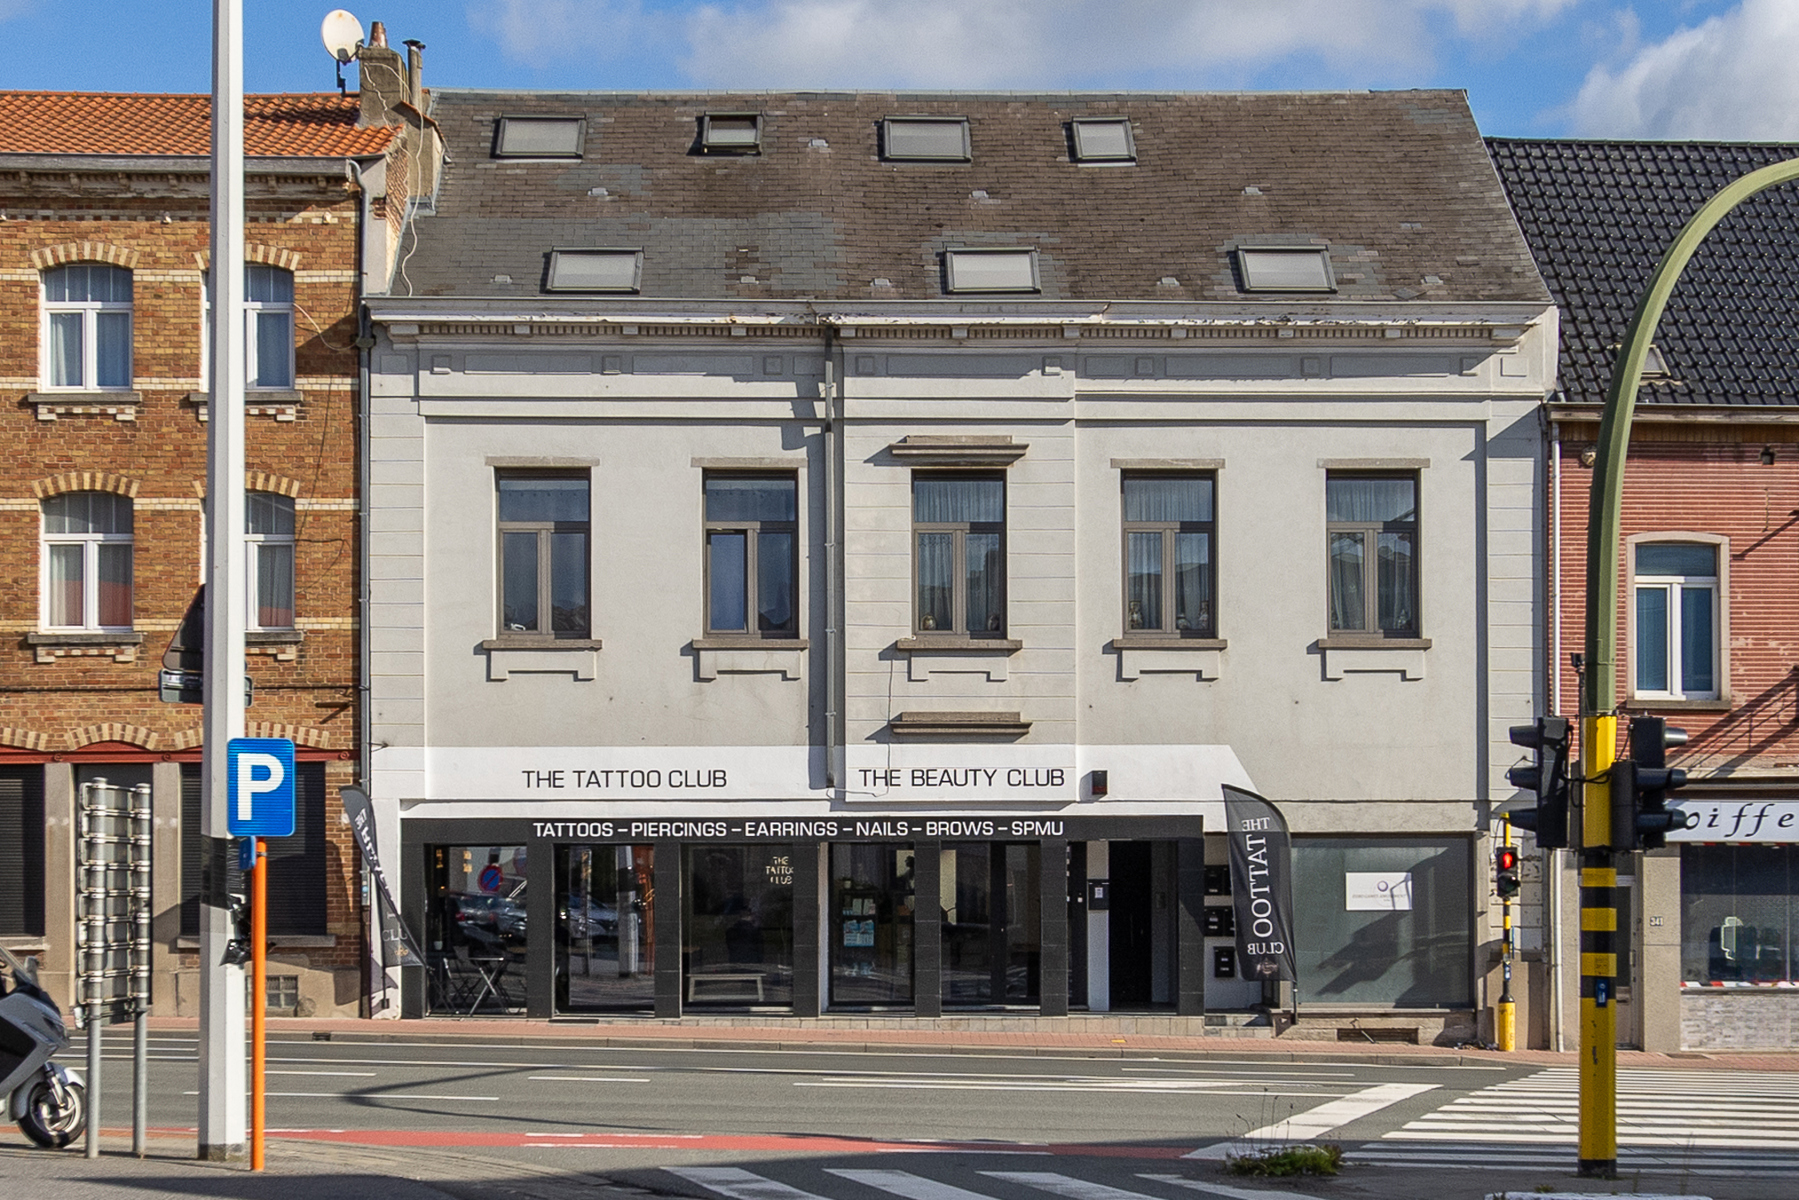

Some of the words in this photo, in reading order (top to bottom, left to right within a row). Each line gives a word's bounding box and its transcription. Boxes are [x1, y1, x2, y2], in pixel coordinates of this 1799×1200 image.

[237, 752, 285, 821] P
[522, 770, 565, 788] THE
[572, 769, 661, 788] TATTOO
[668, 769, 727, 788] CLUB
[859, 769, 901, 787] THE
[911, 769, 997, 787] BEAUTY
[1007, 769, 1065, 787] CLUB
[533, 822, 613, 838] TATTOOS
[631, 822, 727, 838] PIERCINGS
[745, 822, 838, 837] EARRINGS
[856, 822, 908, 837] NAILS
[926, 821, 994, 836] BROWS
[1011, 821, 1064, 836] SPMU
[1684, 803, 1795, 837] oiffe
